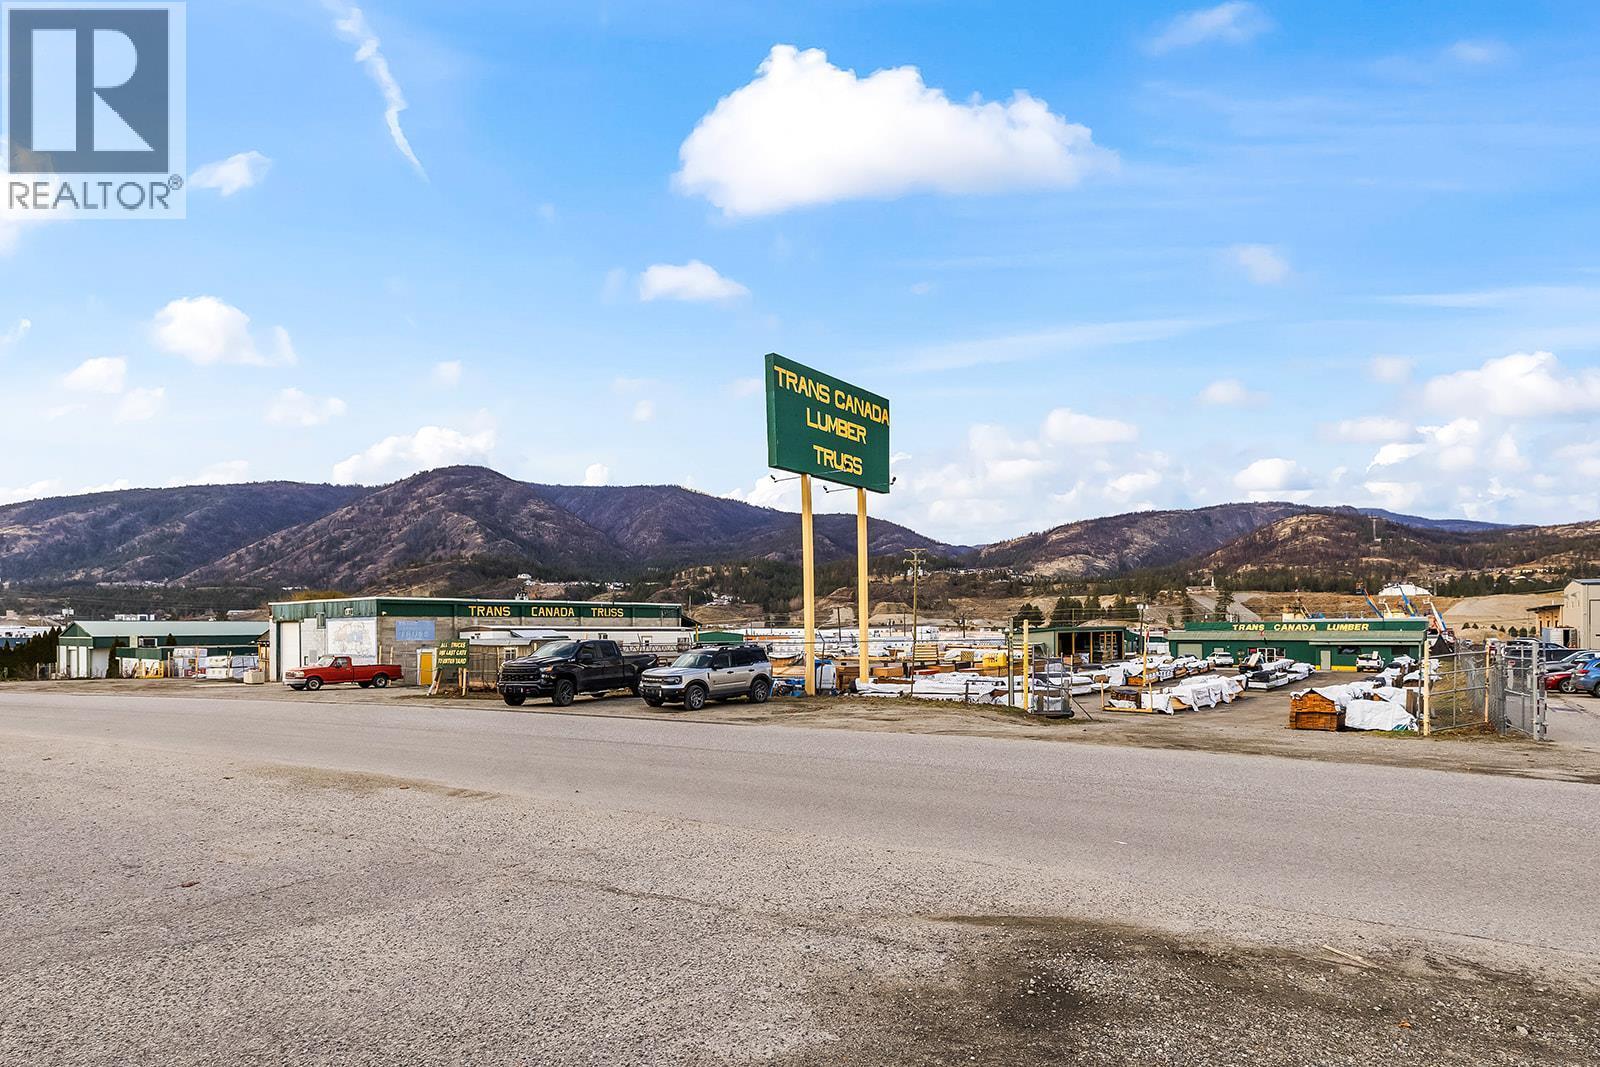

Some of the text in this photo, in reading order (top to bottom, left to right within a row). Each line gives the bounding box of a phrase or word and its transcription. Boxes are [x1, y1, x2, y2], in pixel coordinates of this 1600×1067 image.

[773, 365, 890, 426] TRANS CANADA
[806, 407, 867, 445] LUMBER
[812, 444, 864, 476] TRUSS
[468, 605, 624, 618] TRANS CANADA TRUSS
[1232, 623, 1370, 631] TRANS CANADA LUMBER
